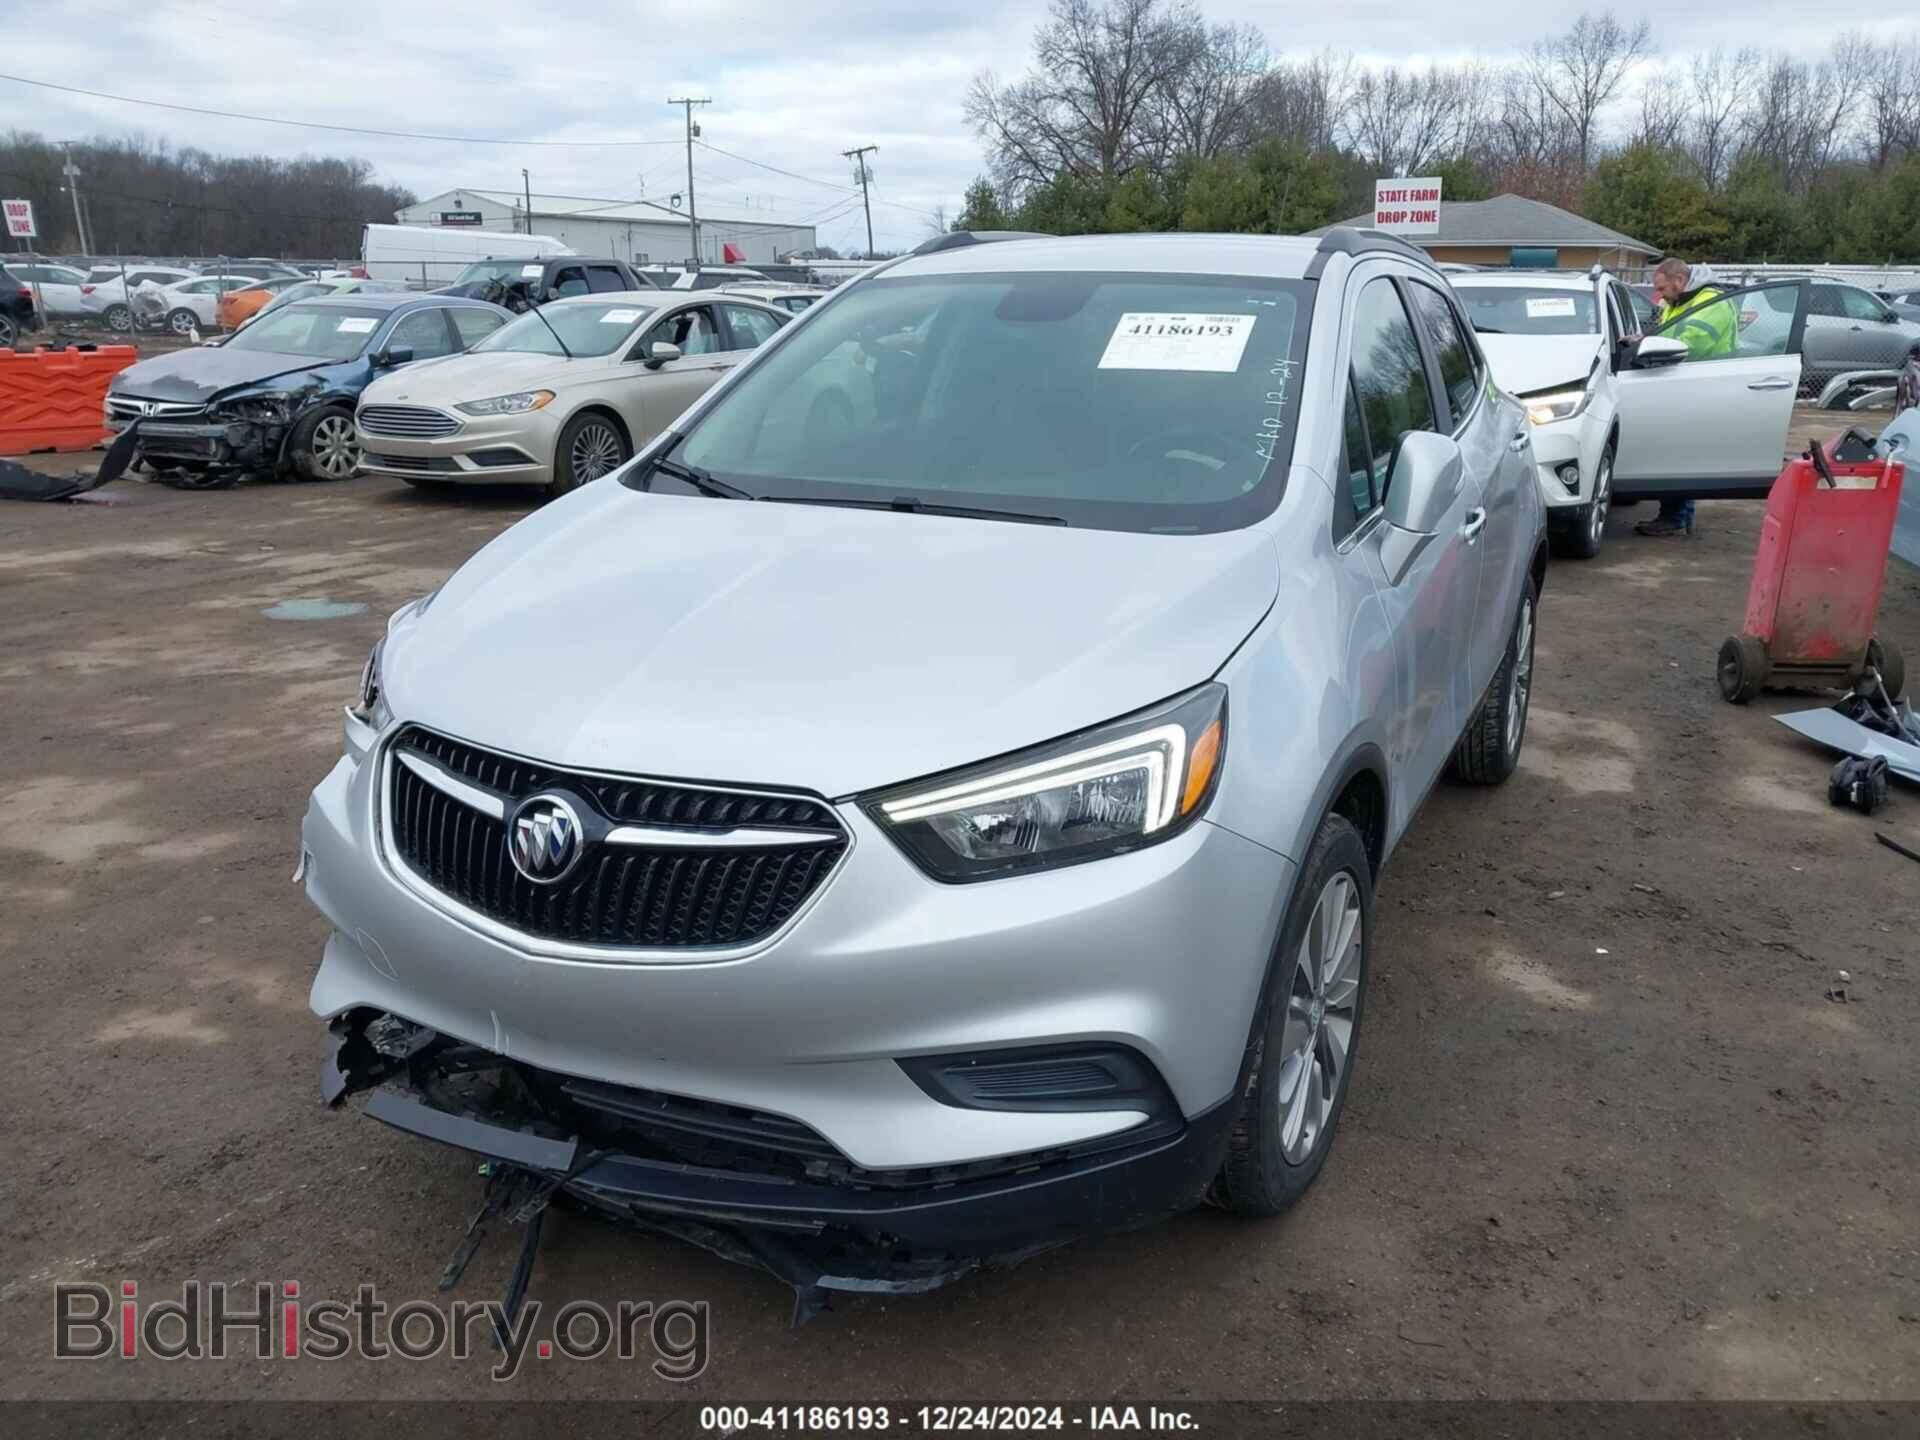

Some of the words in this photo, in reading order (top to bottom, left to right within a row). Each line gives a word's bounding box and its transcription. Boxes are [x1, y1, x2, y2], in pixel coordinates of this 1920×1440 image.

[1378, 190, 1407, 203] STATE
[1410, 188, 1439, 202] FARM
[1377, 211, 1408, 224] DROP
[1409, 210, 1437, 223] ZONE
[1128, 324, 1233, 336] 41186193
